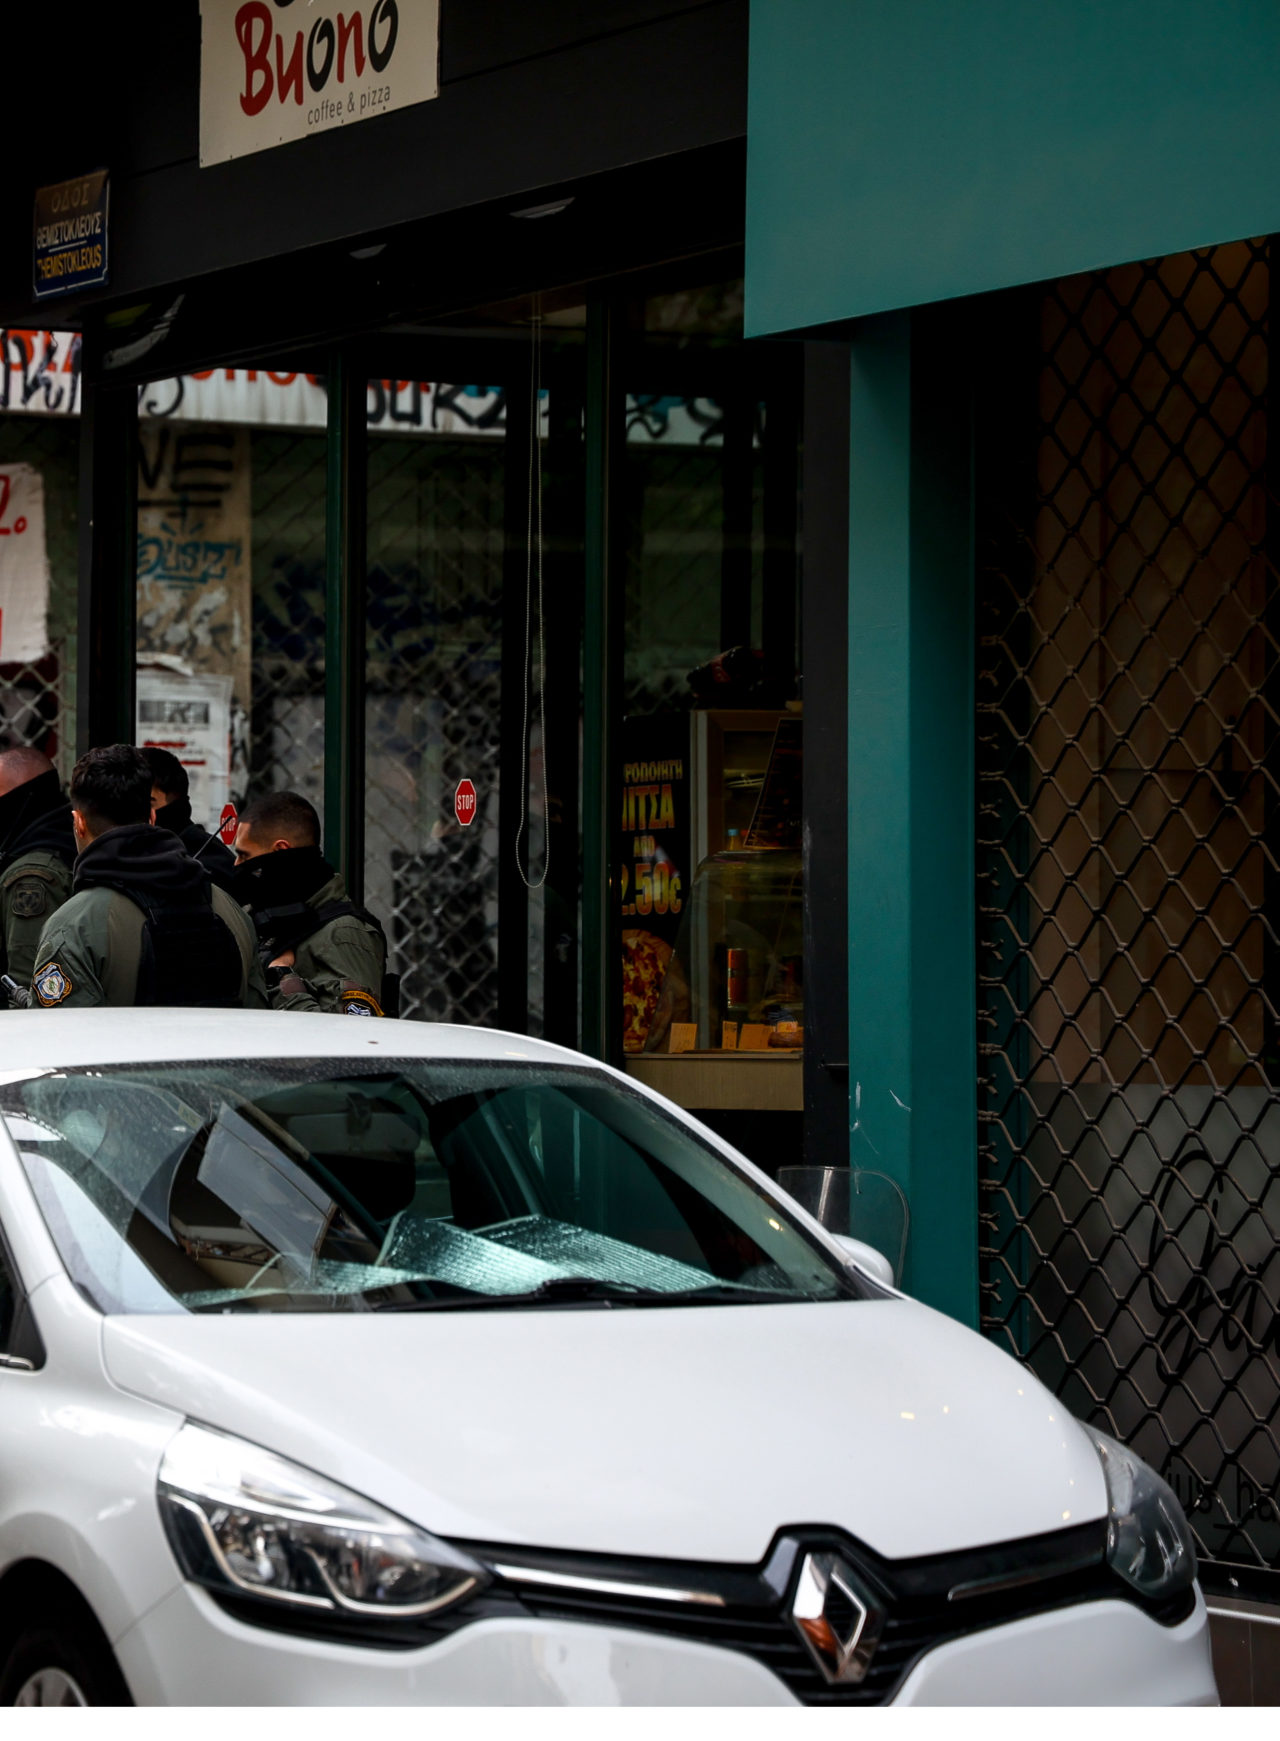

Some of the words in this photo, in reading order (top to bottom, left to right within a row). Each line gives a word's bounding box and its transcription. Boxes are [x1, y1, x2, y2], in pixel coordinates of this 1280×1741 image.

[235, 0, 399, 116] Buono
[307, 98, 343, 125] coffee
[347, 92, 355, 112] &
[360, 85, 391, 115] pizza
[51, 183, 90, 213] ΟΔΟΣ
[36, 211, 102, 250] ΘΕΜΙΣΤΟΚΛΕΟΥΣ
[36, 243, 103, 280] THEMISTOKLEOUS
[458, 795, 474, 810] STOP
